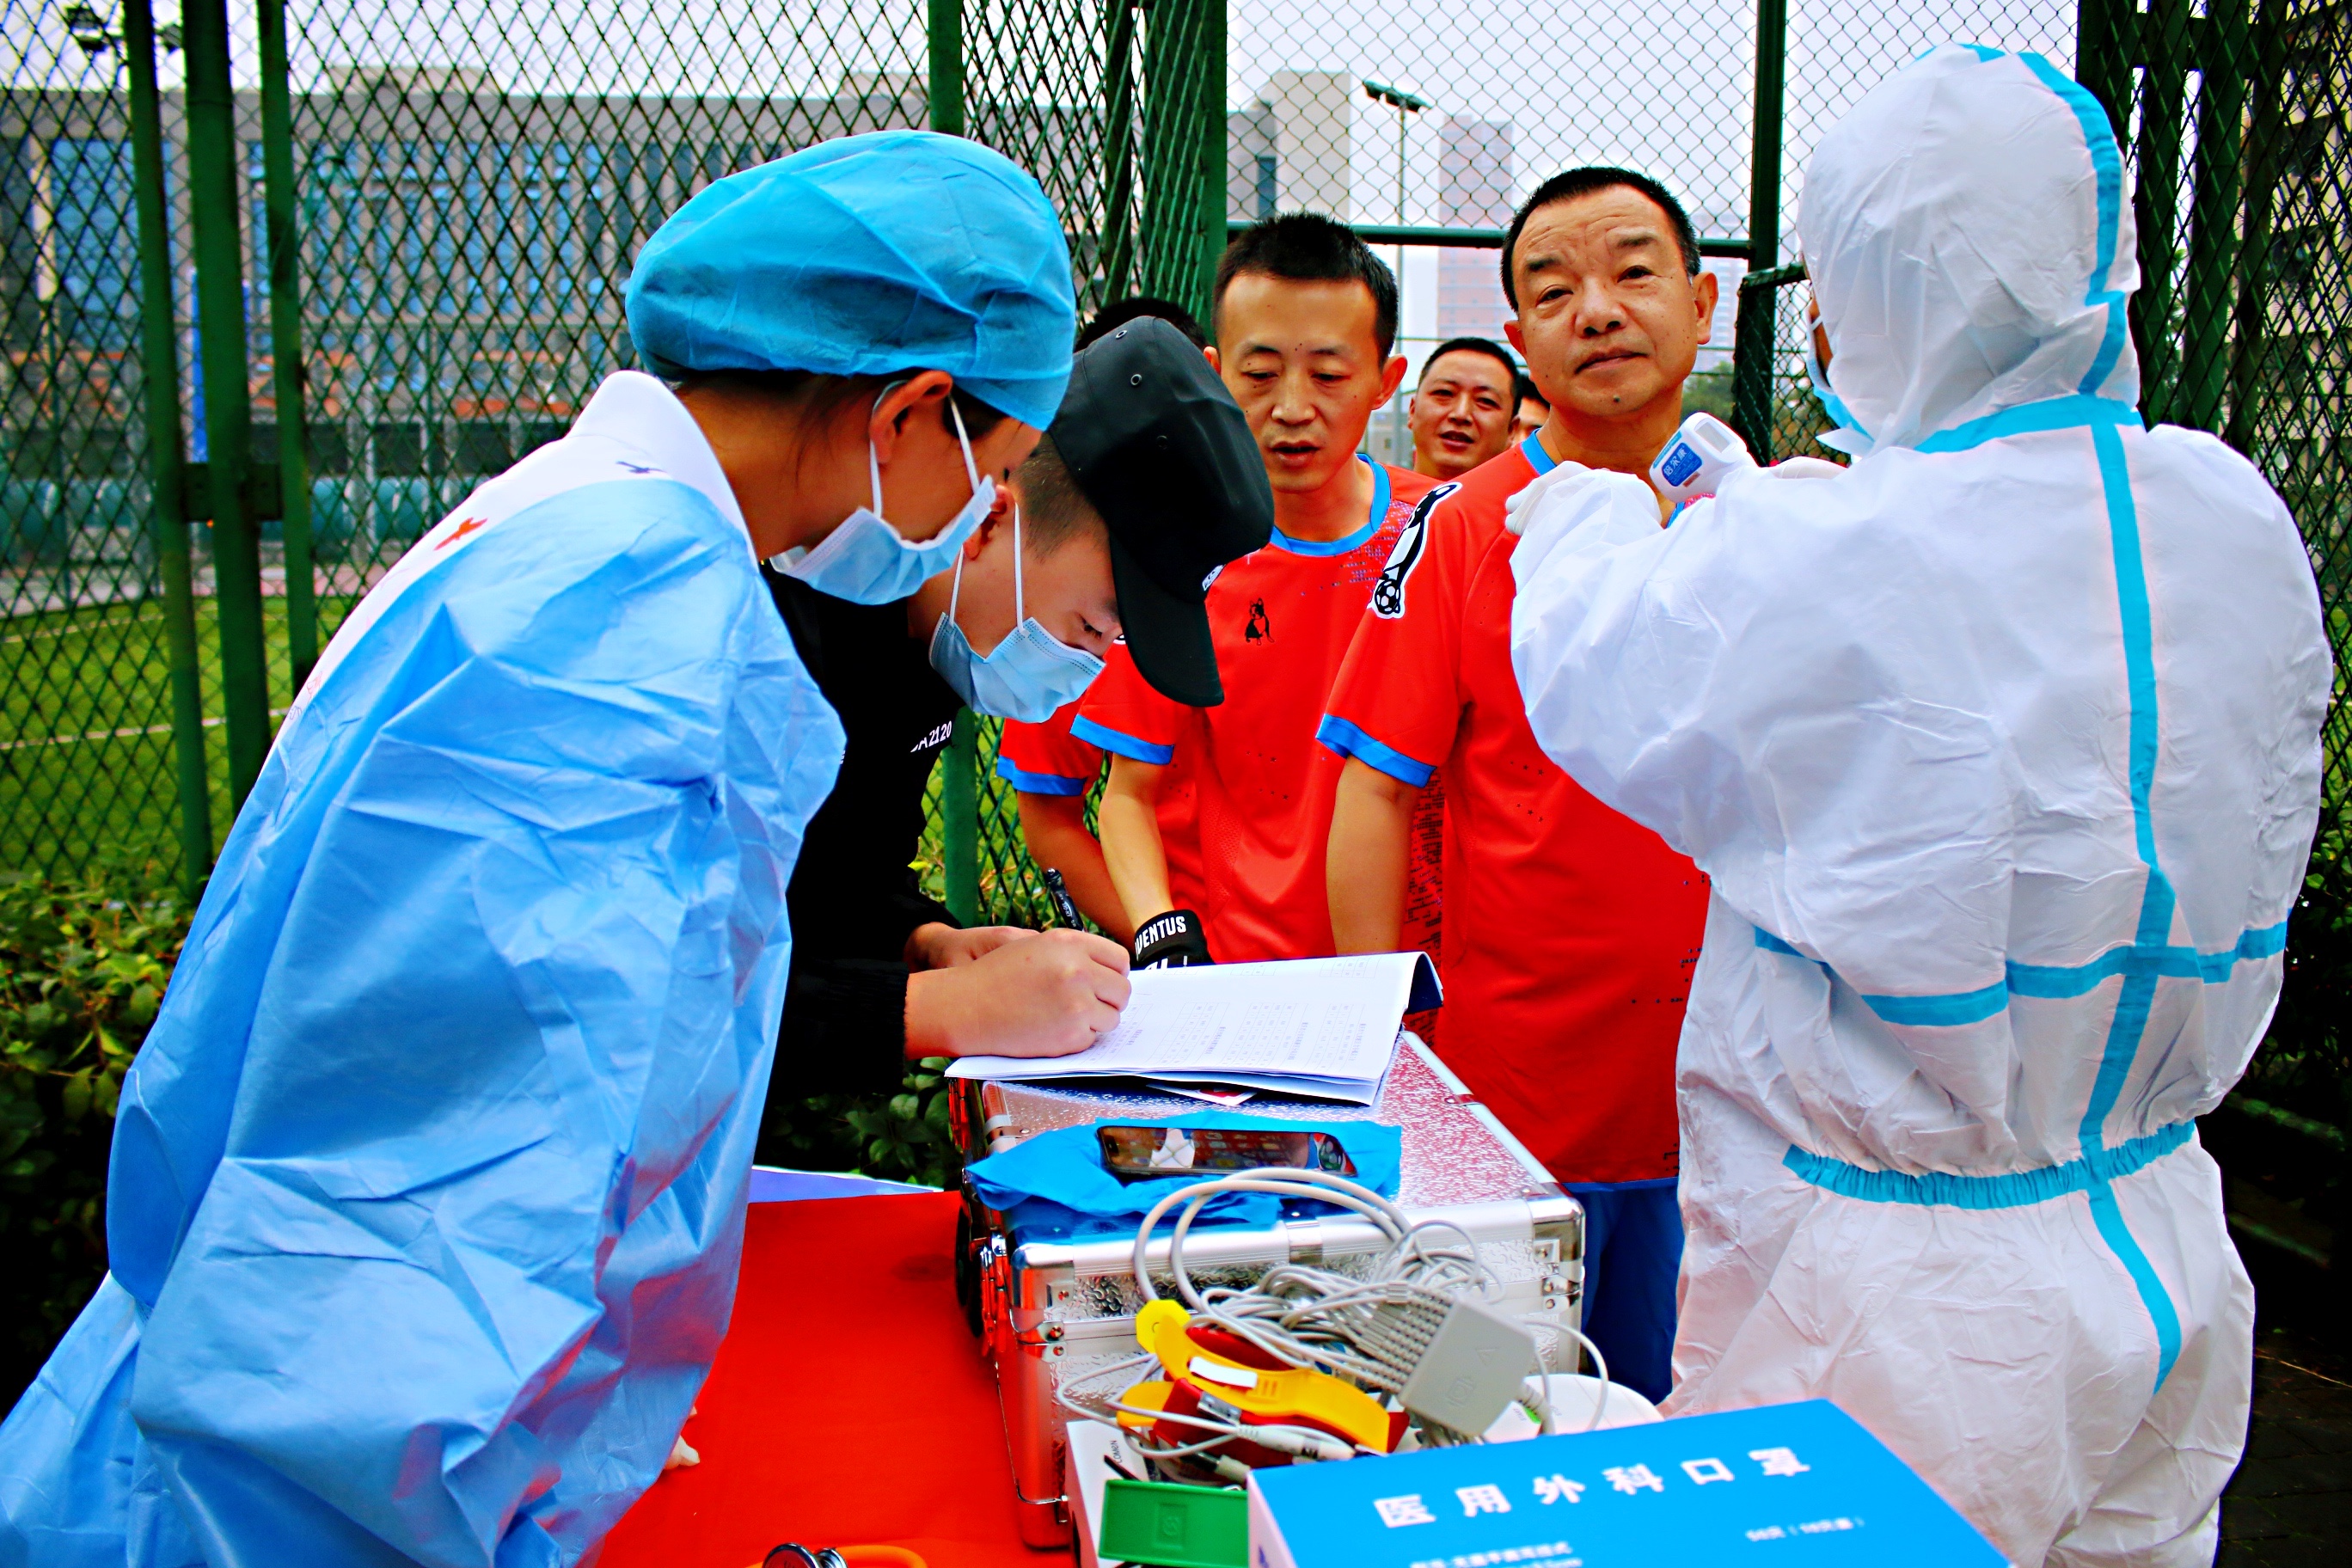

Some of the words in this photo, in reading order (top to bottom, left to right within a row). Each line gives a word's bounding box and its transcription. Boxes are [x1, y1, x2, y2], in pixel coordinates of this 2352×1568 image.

[1374, 1447, 1810, 1528] 医用外科口罩
